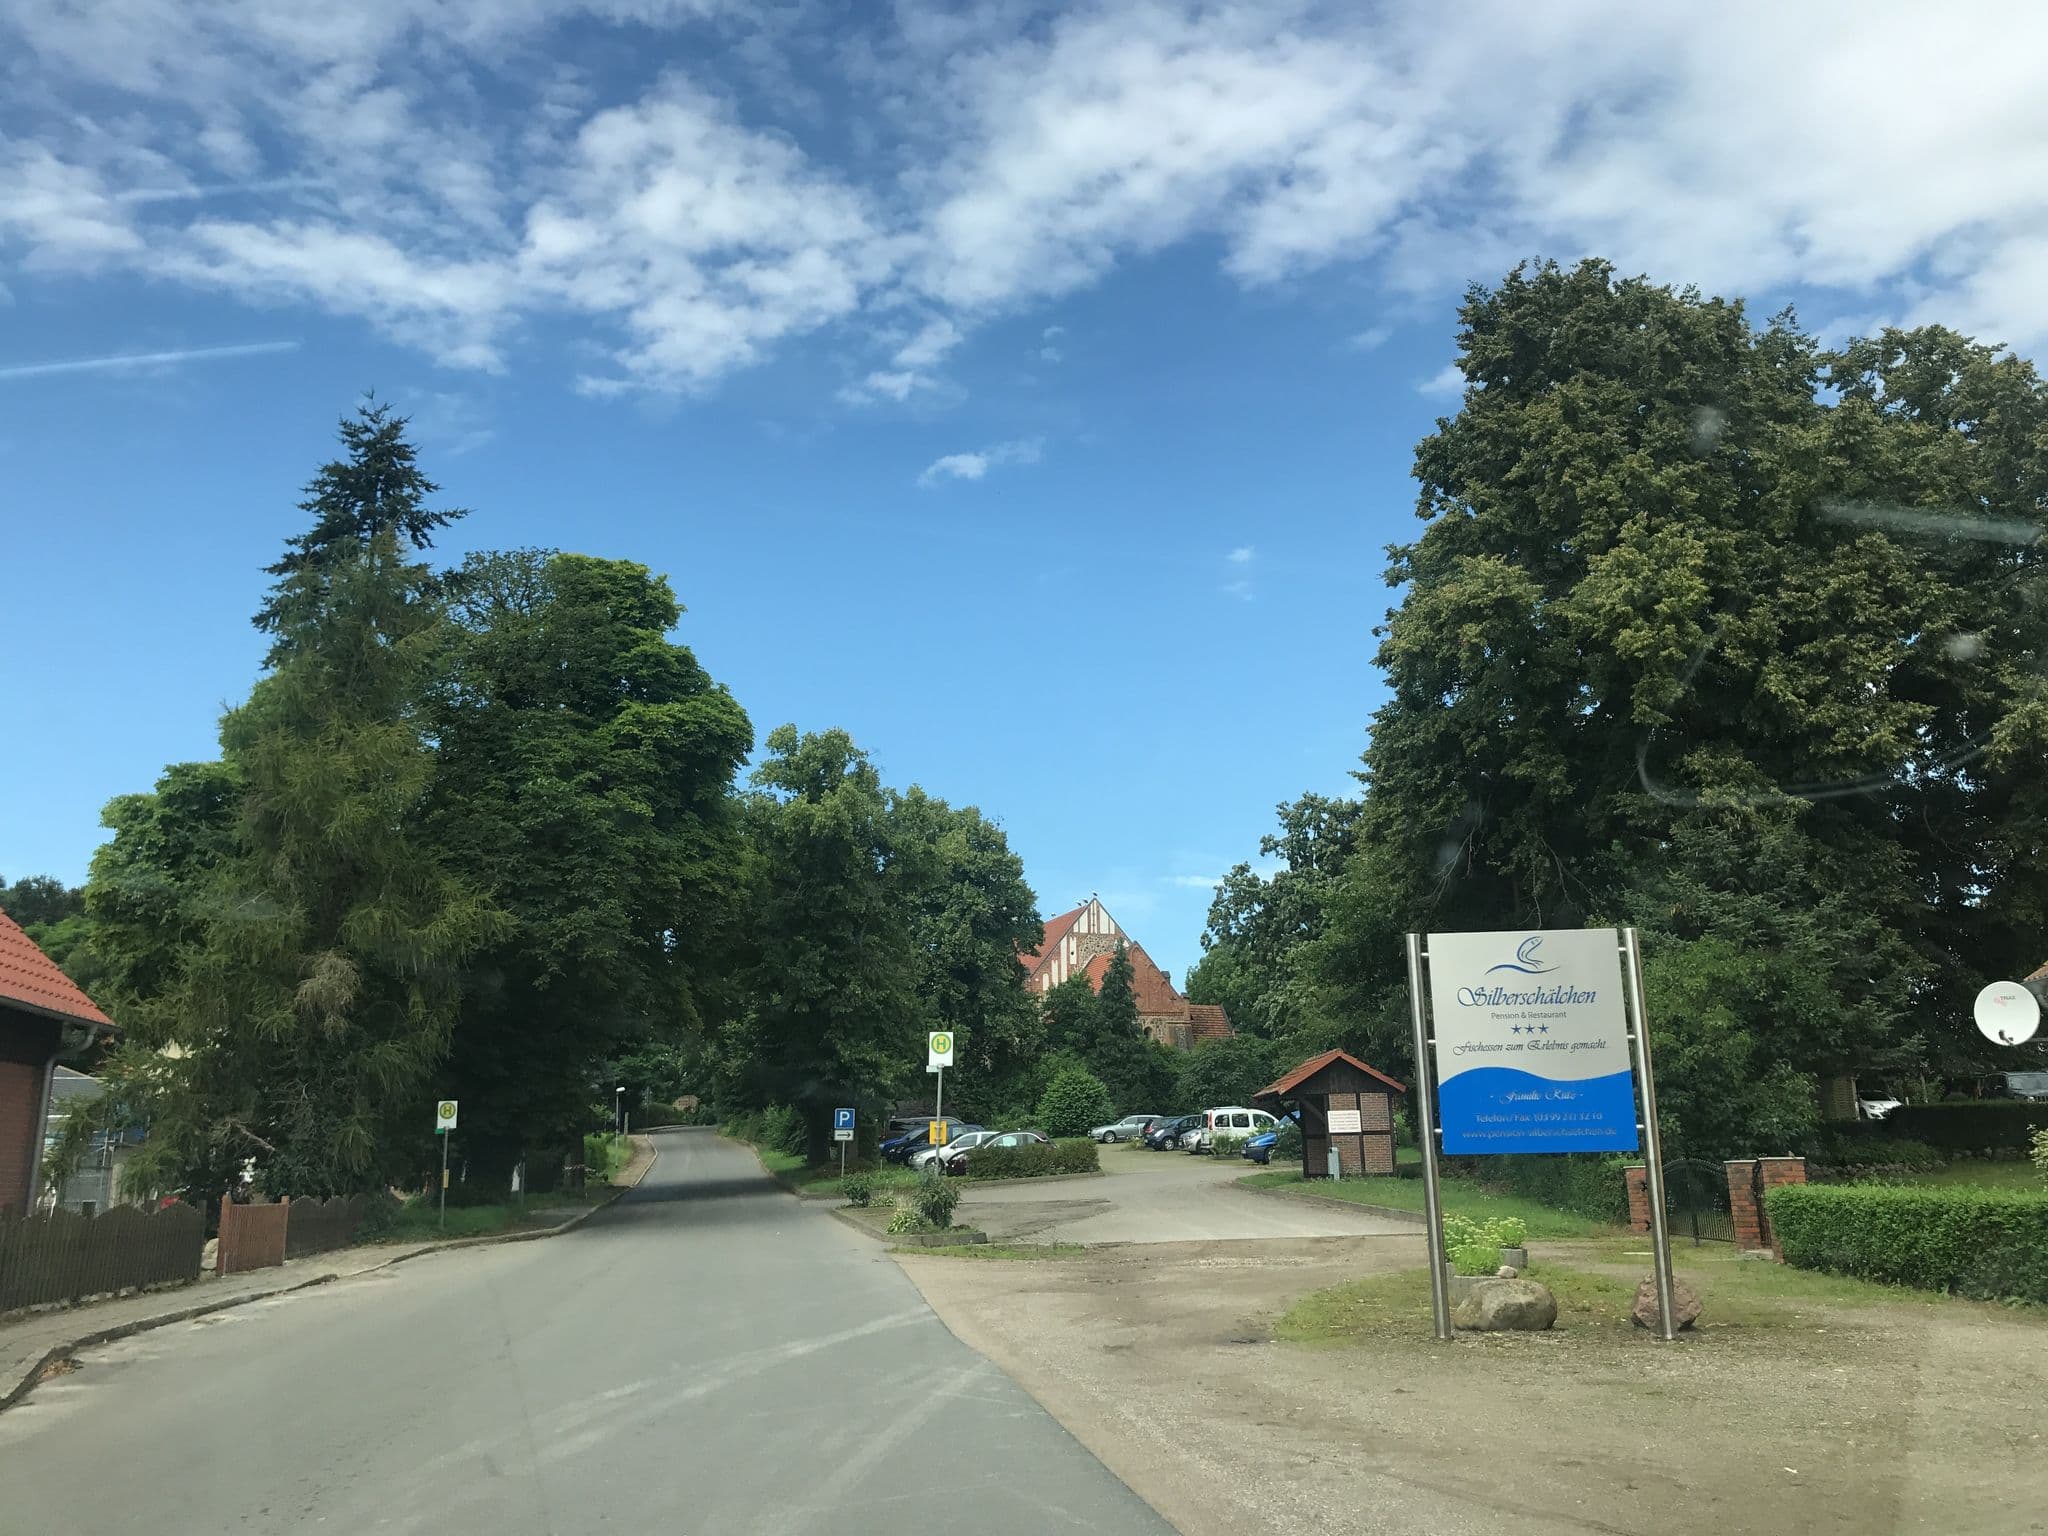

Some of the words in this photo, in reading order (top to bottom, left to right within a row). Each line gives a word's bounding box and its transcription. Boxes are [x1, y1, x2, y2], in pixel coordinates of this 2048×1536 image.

[1457, 985, 1597, 1007] Silberschälchen
[1491, 1012, 1520, 1020] Pension
[1528, 1011, 1567, 1019] Restaurant
[936, 1038, 946, 1050] H
[1453, 1041, 1503, 1056] Fischessen
[1505, 1043, 1524, 1051] zum
[1527, 1039, 1569, 1051] Erlebnis
[839, 1111, 850, 1127] P
